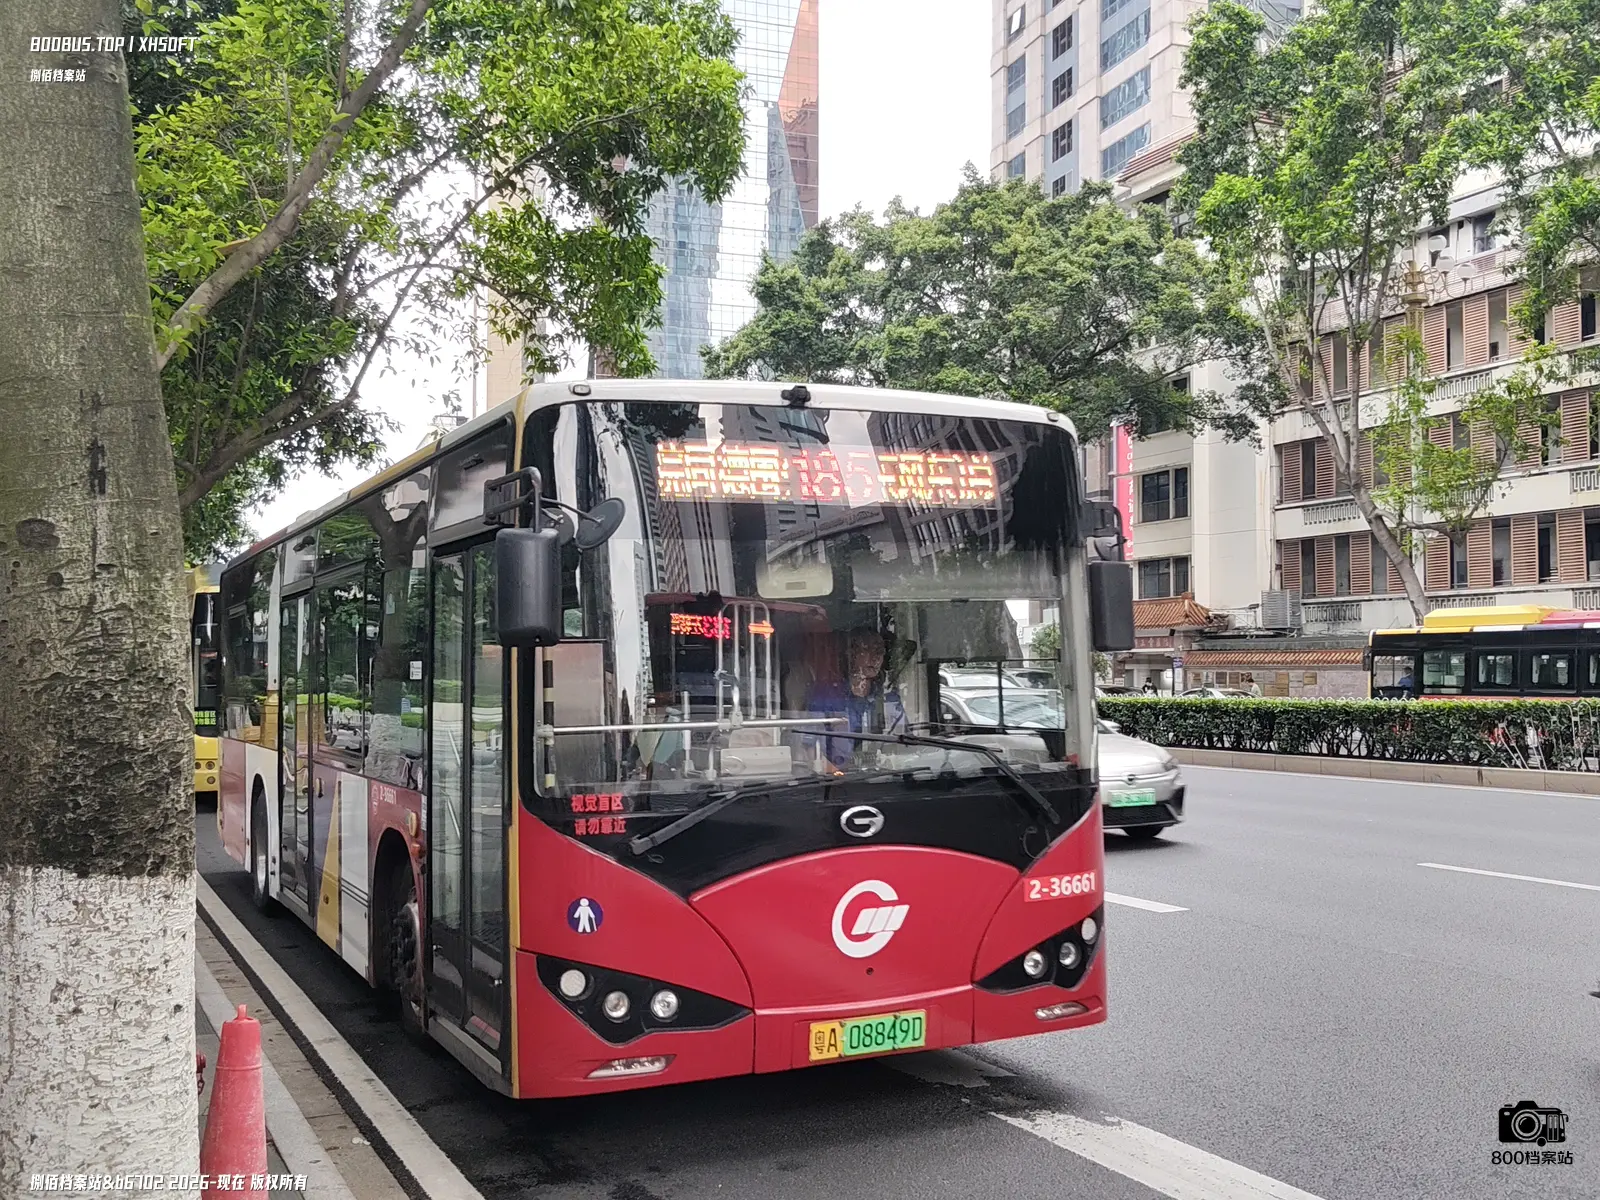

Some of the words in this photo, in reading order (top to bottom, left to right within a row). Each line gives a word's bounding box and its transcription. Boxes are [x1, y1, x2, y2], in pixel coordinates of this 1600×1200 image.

[792, 450, 874, 501] 185
[571, 792, 624, 812] 视觉盲区
[574, 817, 626, 835] 请勿靠近
[1029, 872, 1095, 899] 2-36661
